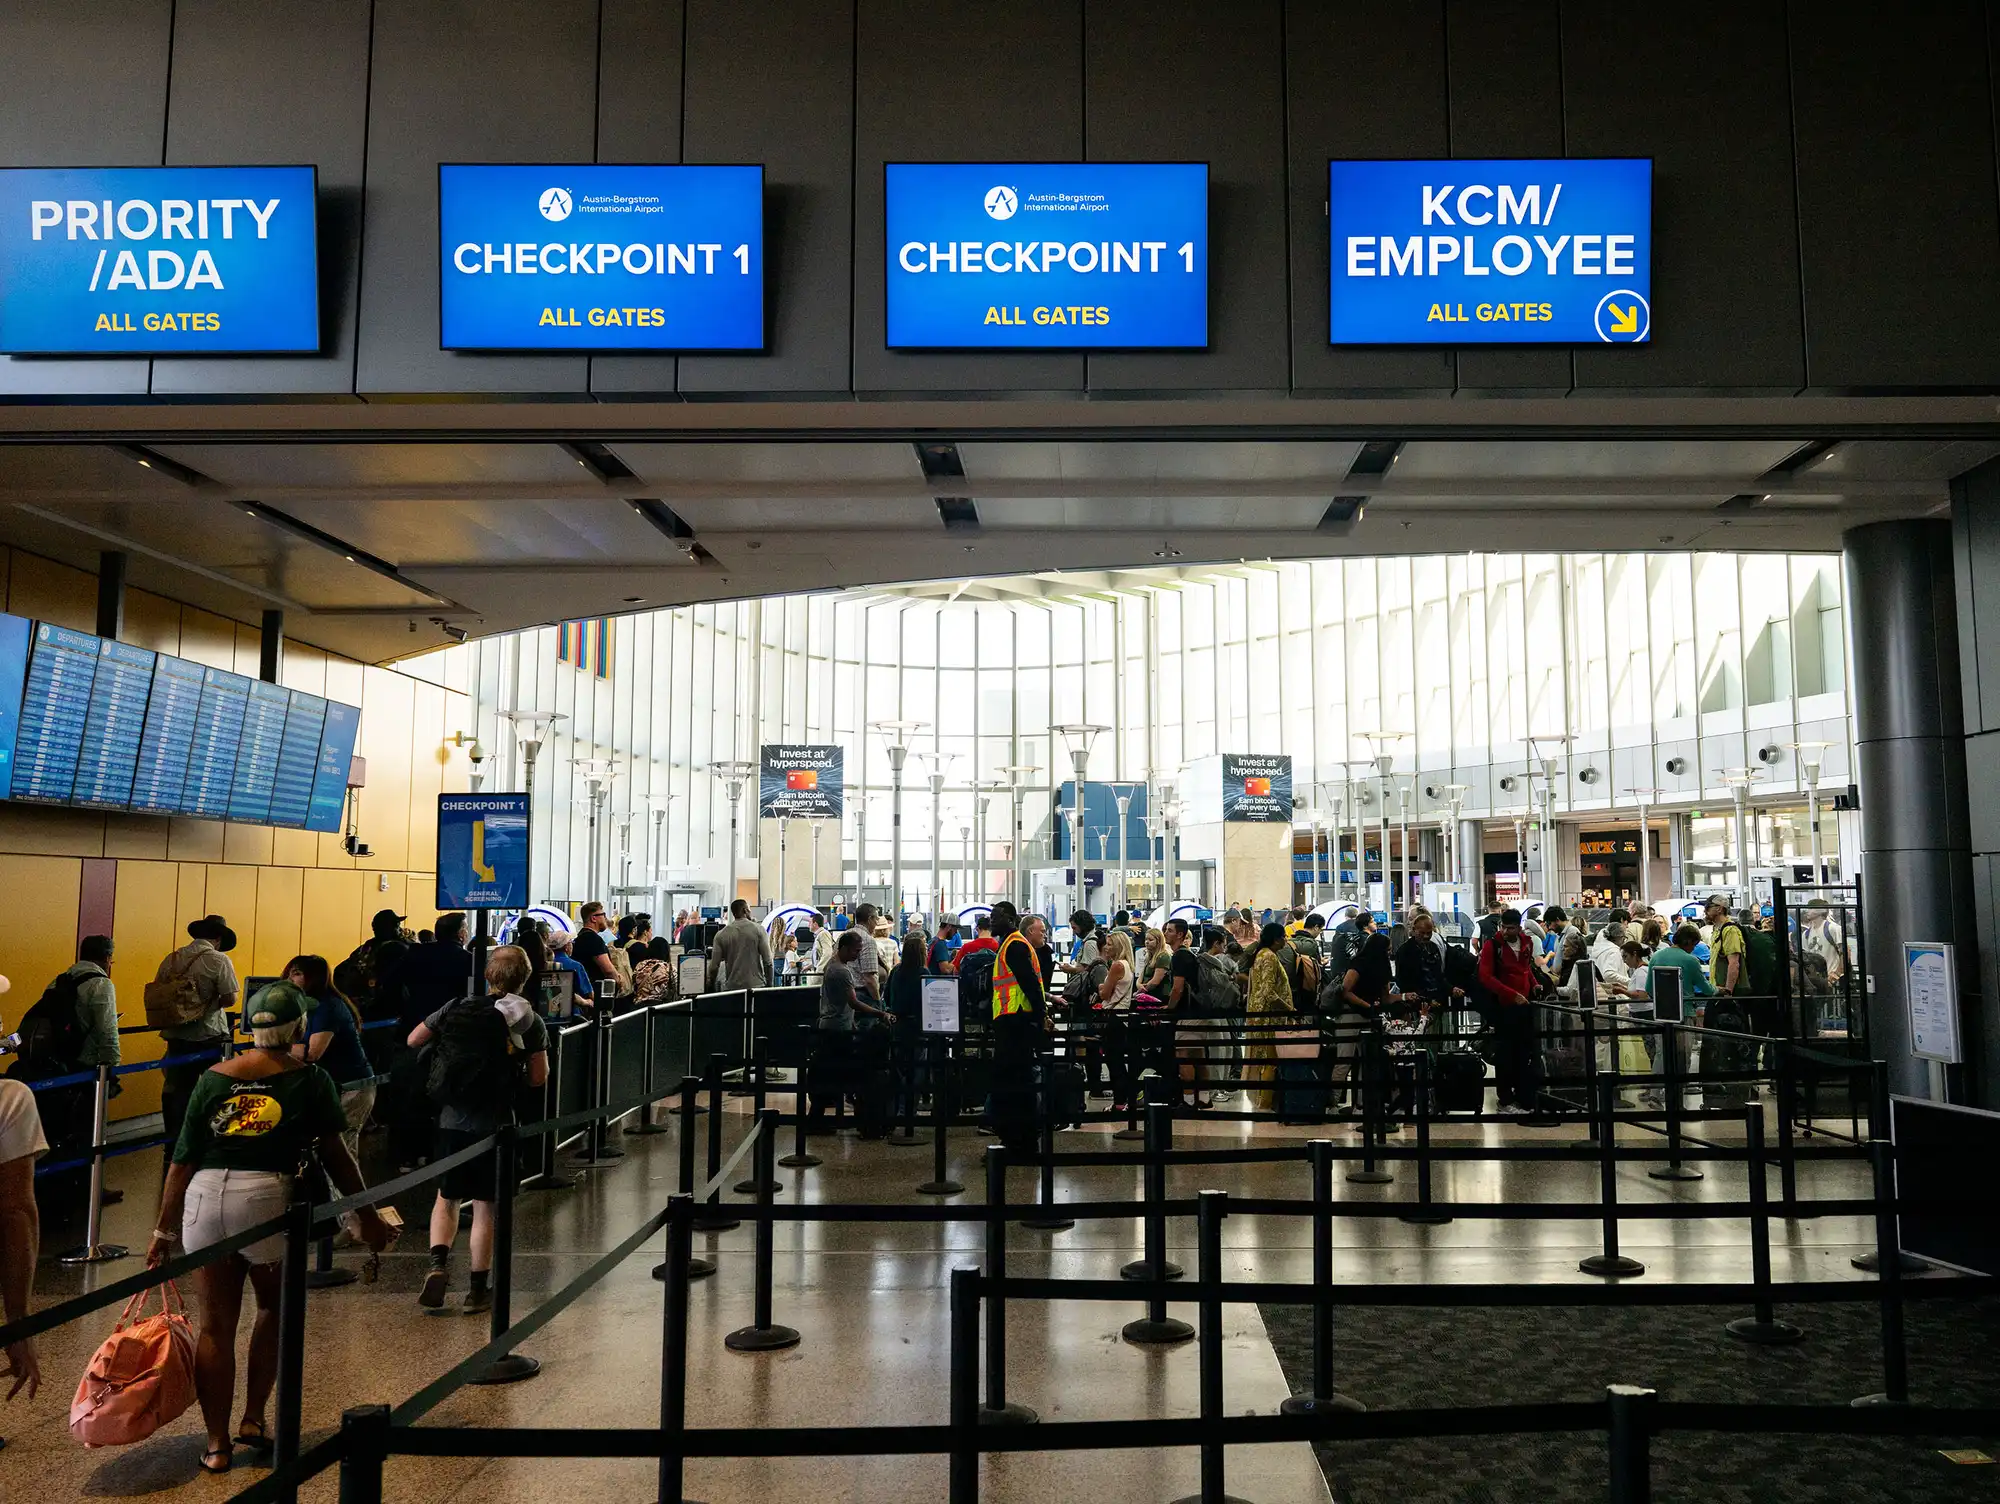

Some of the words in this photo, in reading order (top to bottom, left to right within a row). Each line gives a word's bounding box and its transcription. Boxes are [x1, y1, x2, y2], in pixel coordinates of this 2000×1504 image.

[583, 195, 659, 204] Austin-Bergstrom
[1028, 193, 1104, 203] Austin-Bergstrom
[1422, 183, 1562, 226] KCM/
[578, 205, 632, 213] International
[634, 205, 664, 214] Airport
[1024, 203, 1077, 211] International
[1080, 203, 1109, 212] Airport
[31, 199, 281, 241] PRIORITY
[453, 242, 722, 275] CHECKPOINT
[732, 244, 749, 275] 1
[899, 241, 1167, 273] CHECKPOINT
[1177, 241, 1194, 273] 1
[1347, 234, 1635, 277] EMPLOYEE
[88, 249, 225, 292] /ADA
[538, 307, 582, 327] ALL
[587, 307, 666, 327] GATES
[983, 306, 1027, 325] ALL
[1032, 306, 1110, 325] GATES
[1427, 303, 1470, 322] ALL
[1475, 302, 1553, 322] GATES
[94, 313, 137, 332] ALL
[143, 312, 221, 332] GATES
[57, 632, 97, 650] DEPARTURES
[779, 749, 813, 758] Invest
[814, 750, 826, 758] at
[769, 758, 834, 769] hyperspeed.
[1238, 758, 1265, 767] Invest
[1267, 759, 1277, 767] at
[1230, 766, 1284, 776] hyperspeed.
[441, 801, 516, 810] CHECKPOINT
[518, 801, 525, 810] 1
[1580, 840, 1616, 855] ATX
[237, 1096, 267, 1109] Bass
[239, 1108, 259, 1120] Pro
[236, 1120, 272, 1133] Shops
